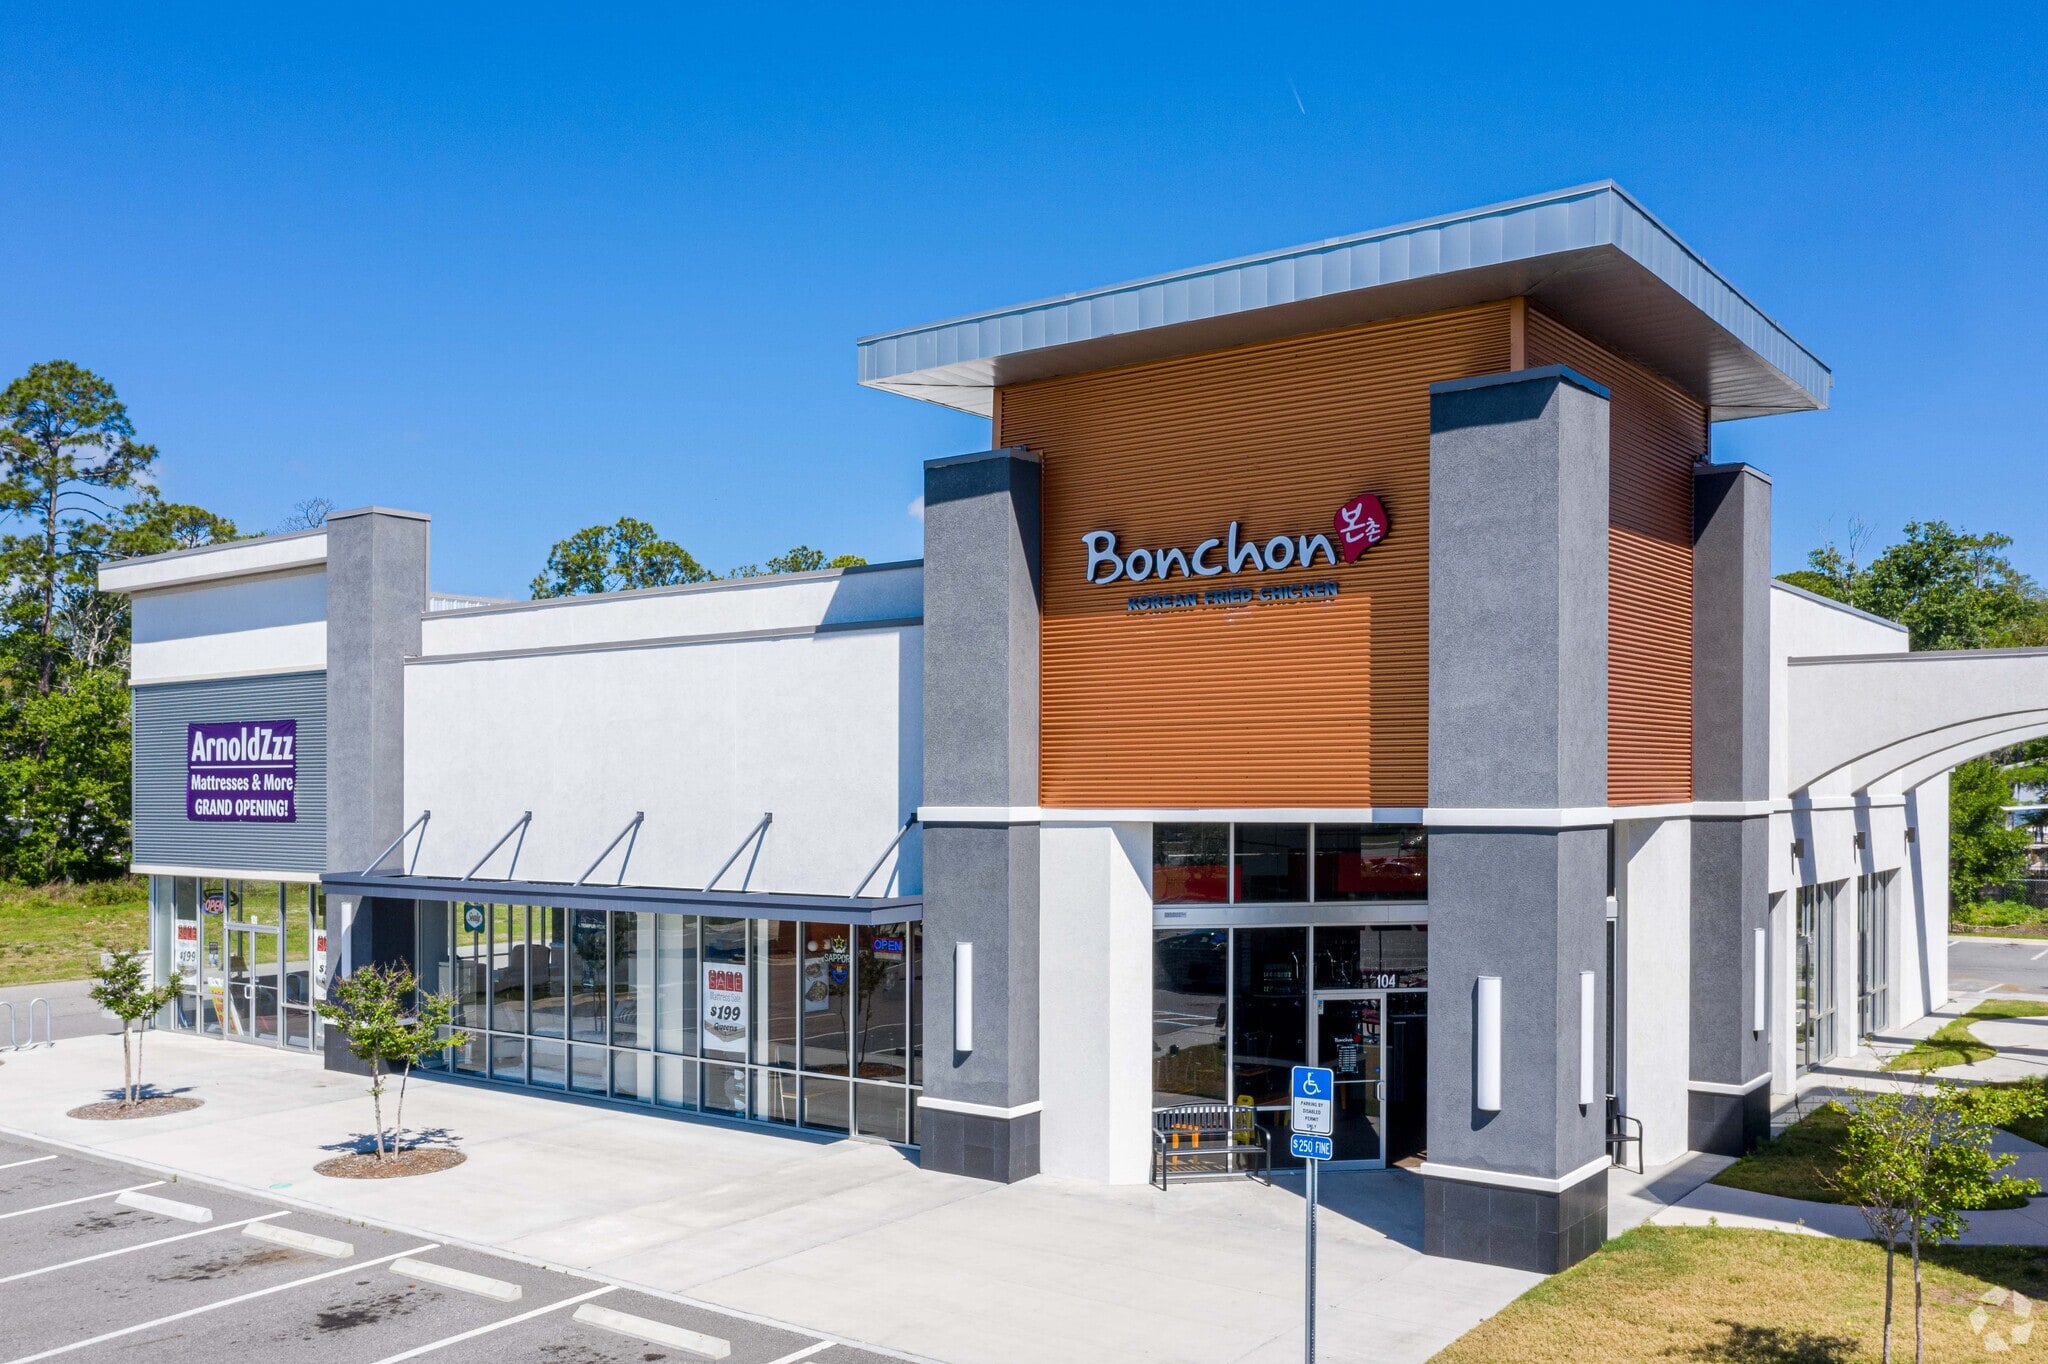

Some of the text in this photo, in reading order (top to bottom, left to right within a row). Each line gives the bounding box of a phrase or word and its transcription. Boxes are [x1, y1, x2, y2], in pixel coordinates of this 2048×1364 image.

[1082, 520, 1339, 585] Bonchon
[1127, 582, 1338, 611] KOREAN FRIED CHICKEN
[191, 727, 294, 761] ArnoldZzz
[191, 773, 294, 791] Mattresses & More
[195, 799, 289, 817] GRAND OPENING!
[204, 899, 224, 912] OPEN
[874, 939, 903, 952] OPEN
[180, 951, 197, 962] $199
[824, 953, 851, 963] SAPPOR
[709, 973, 743, 991] SALE
[1376, 973, 1396, 988] 104
[710, 1005, 741, 1021] $199
[714, 1022, 738, 1032] Queens
[1315, 1142, 1330, 1155] FINE
